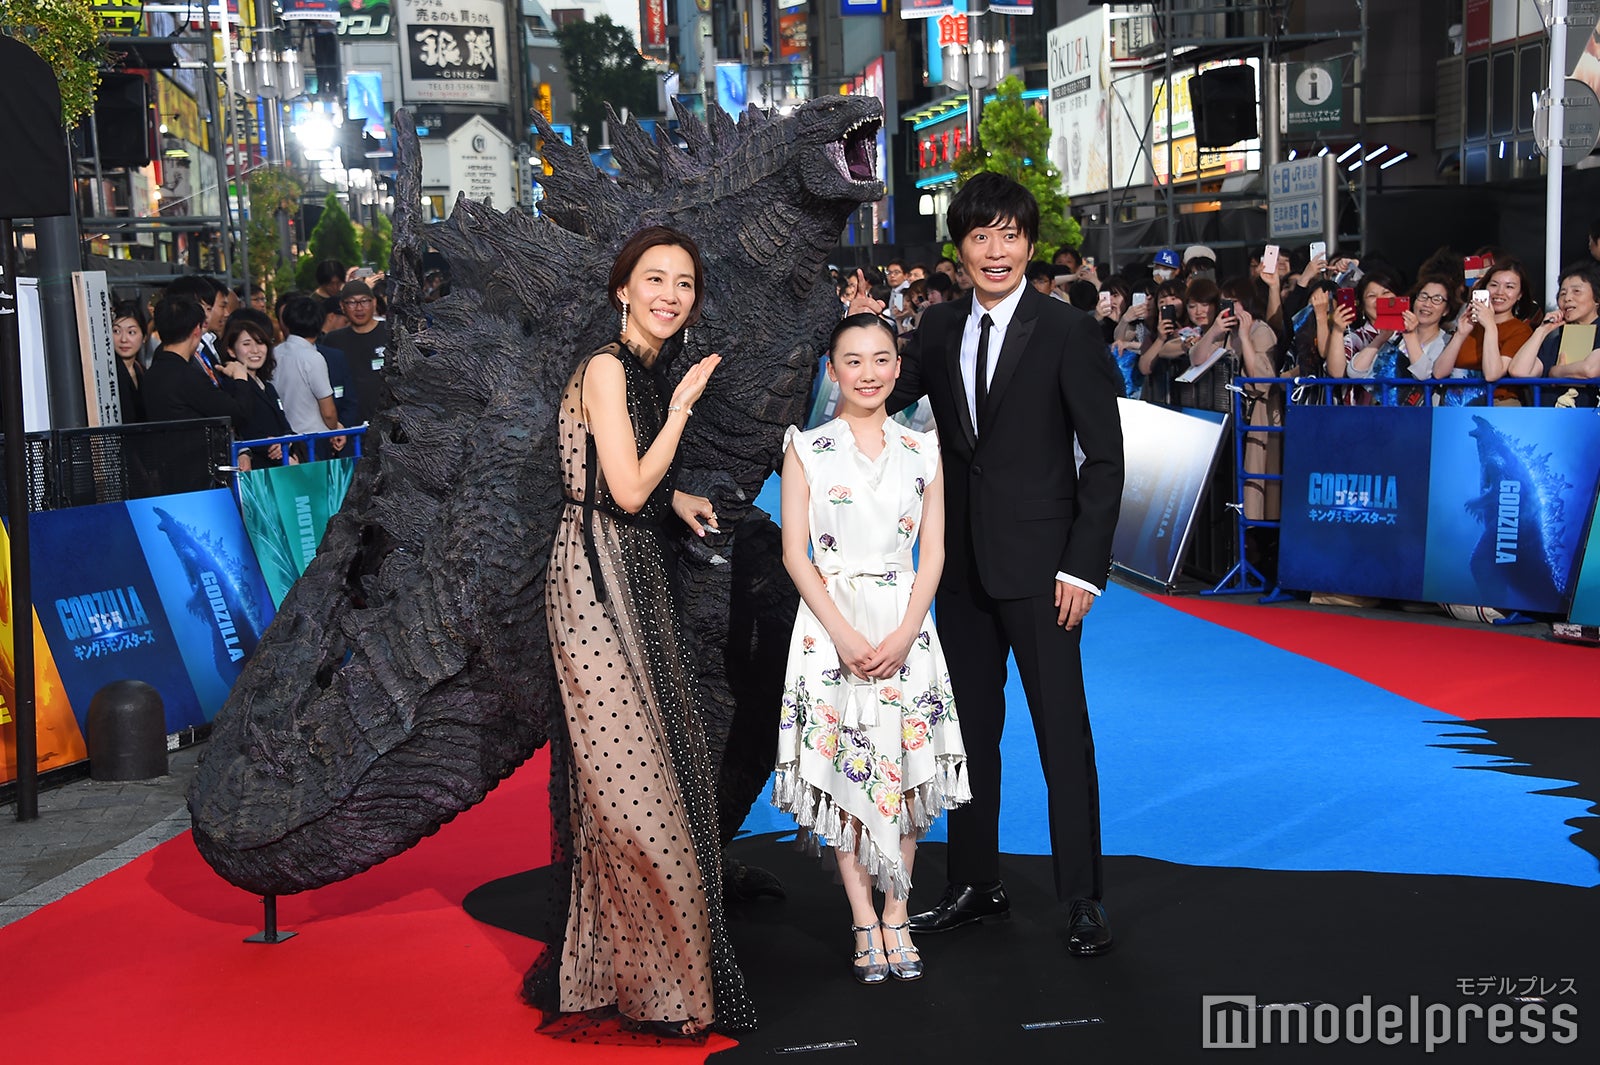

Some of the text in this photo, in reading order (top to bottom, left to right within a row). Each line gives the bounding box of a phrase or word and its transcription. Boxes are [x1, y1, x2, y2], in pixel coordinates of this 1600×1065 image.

[415, 28, 494, 71] 銀蔵
[1308, 472, 1398, 509] GODZILLA
[1335, 489, 1370, 507] ゴジラ
[295, 495, 317, 568] MOTHR
[1495, 480, 1521, 564] GODZILLA
[55, 586, 150, 641] GODZILLA
[88, 610, 123, 634] ゴジラ
[200, 571, 246, 662] GODZILLA
